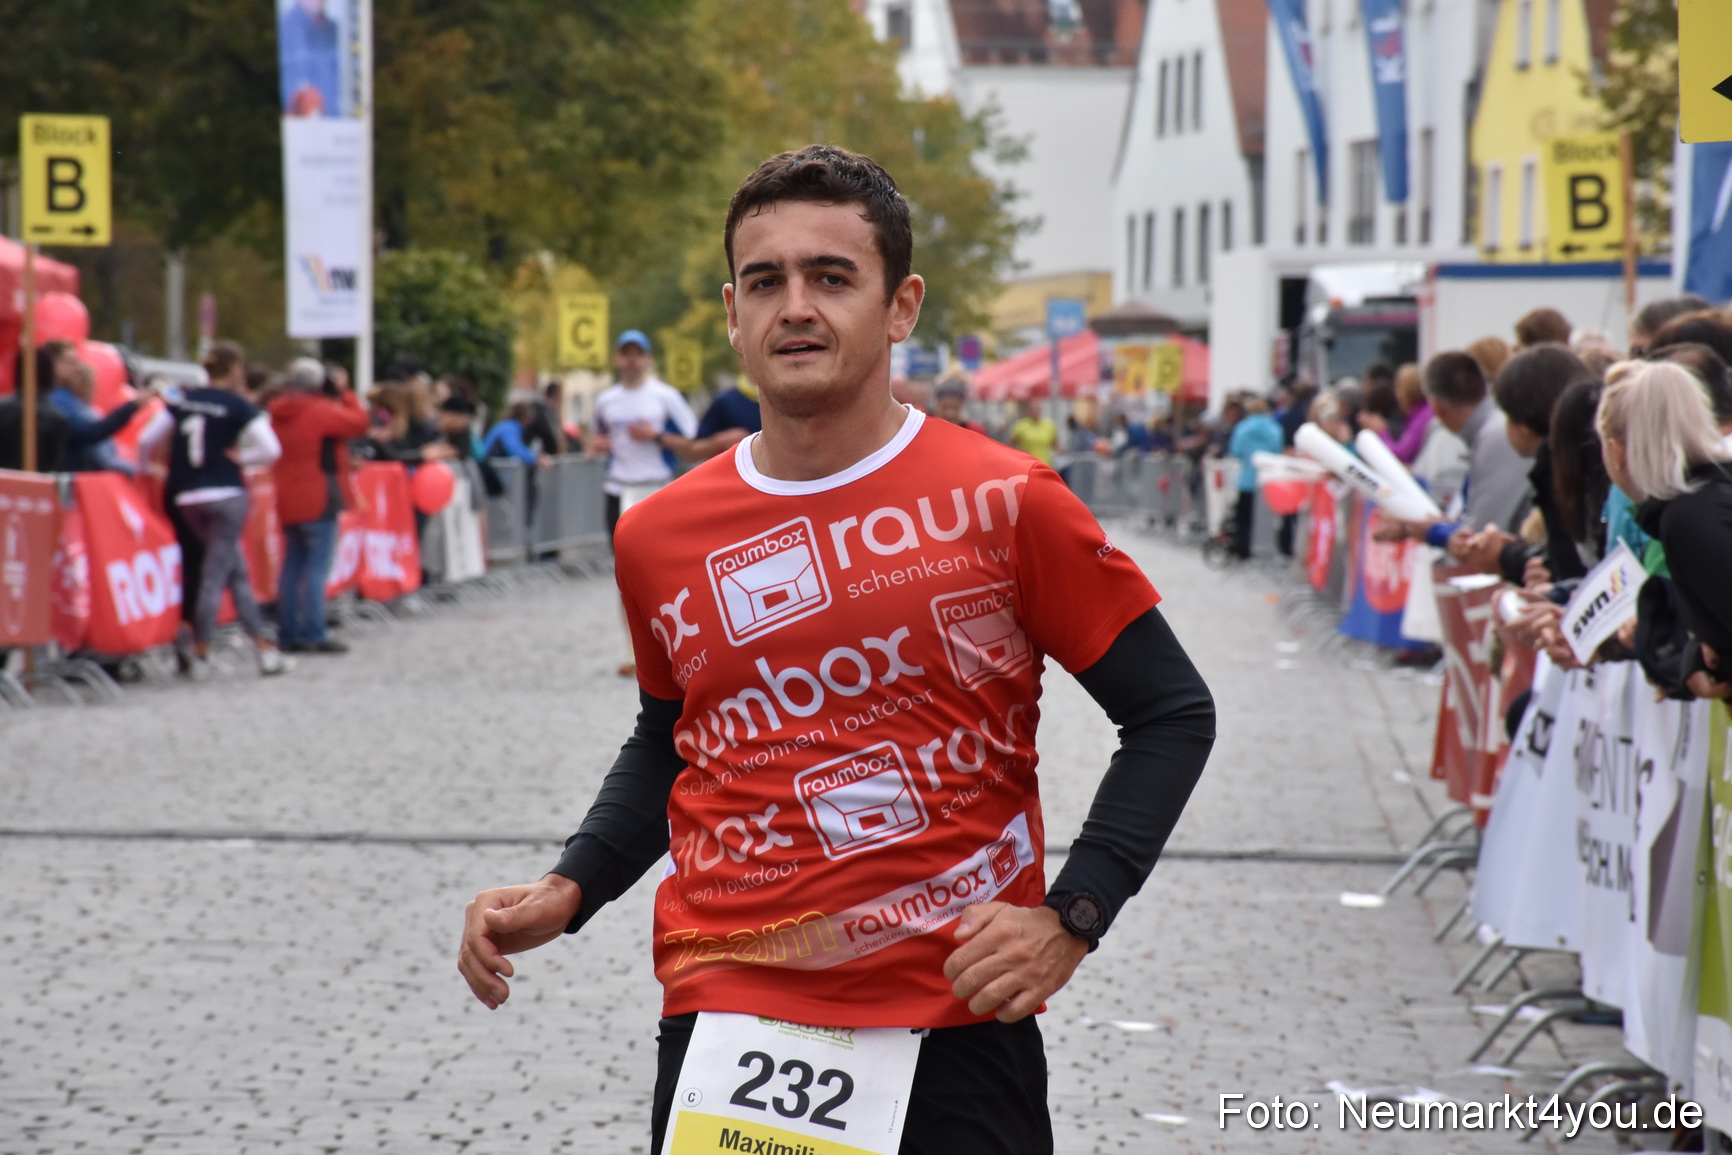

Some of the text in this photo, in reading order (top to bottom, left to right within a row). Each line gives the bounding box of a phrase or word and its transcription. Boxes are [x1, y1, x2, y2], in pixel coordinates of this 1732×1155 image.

[32, 123, 97, 146] Block
[47, 157, 86, 213] B
[1569, 173, 1610, 231] B
[570, 316, 595, 349] C
[180, 414, 206, 468] 1
[714, 528, 806, 577] raumbox
[847, 556, 970, 599] schenken
[1572, 591, 1610, 640] swn
[739, 729, 825, 773] wohnen
[844, 687, 935, 732] outdoor
[803, 752, 895, 797] raumbox
[727, 858, 799, 895] outdoor
[664, 863, 987, 971] Team raumbox
[854, 929, 905, 955] schenken
[912, 912, 949, 934] wohnen
[687, 1092, 696, 1103] C
[729, 1050, 855, 1131] 232
[718, 1128, 823, 1155] Maximili
